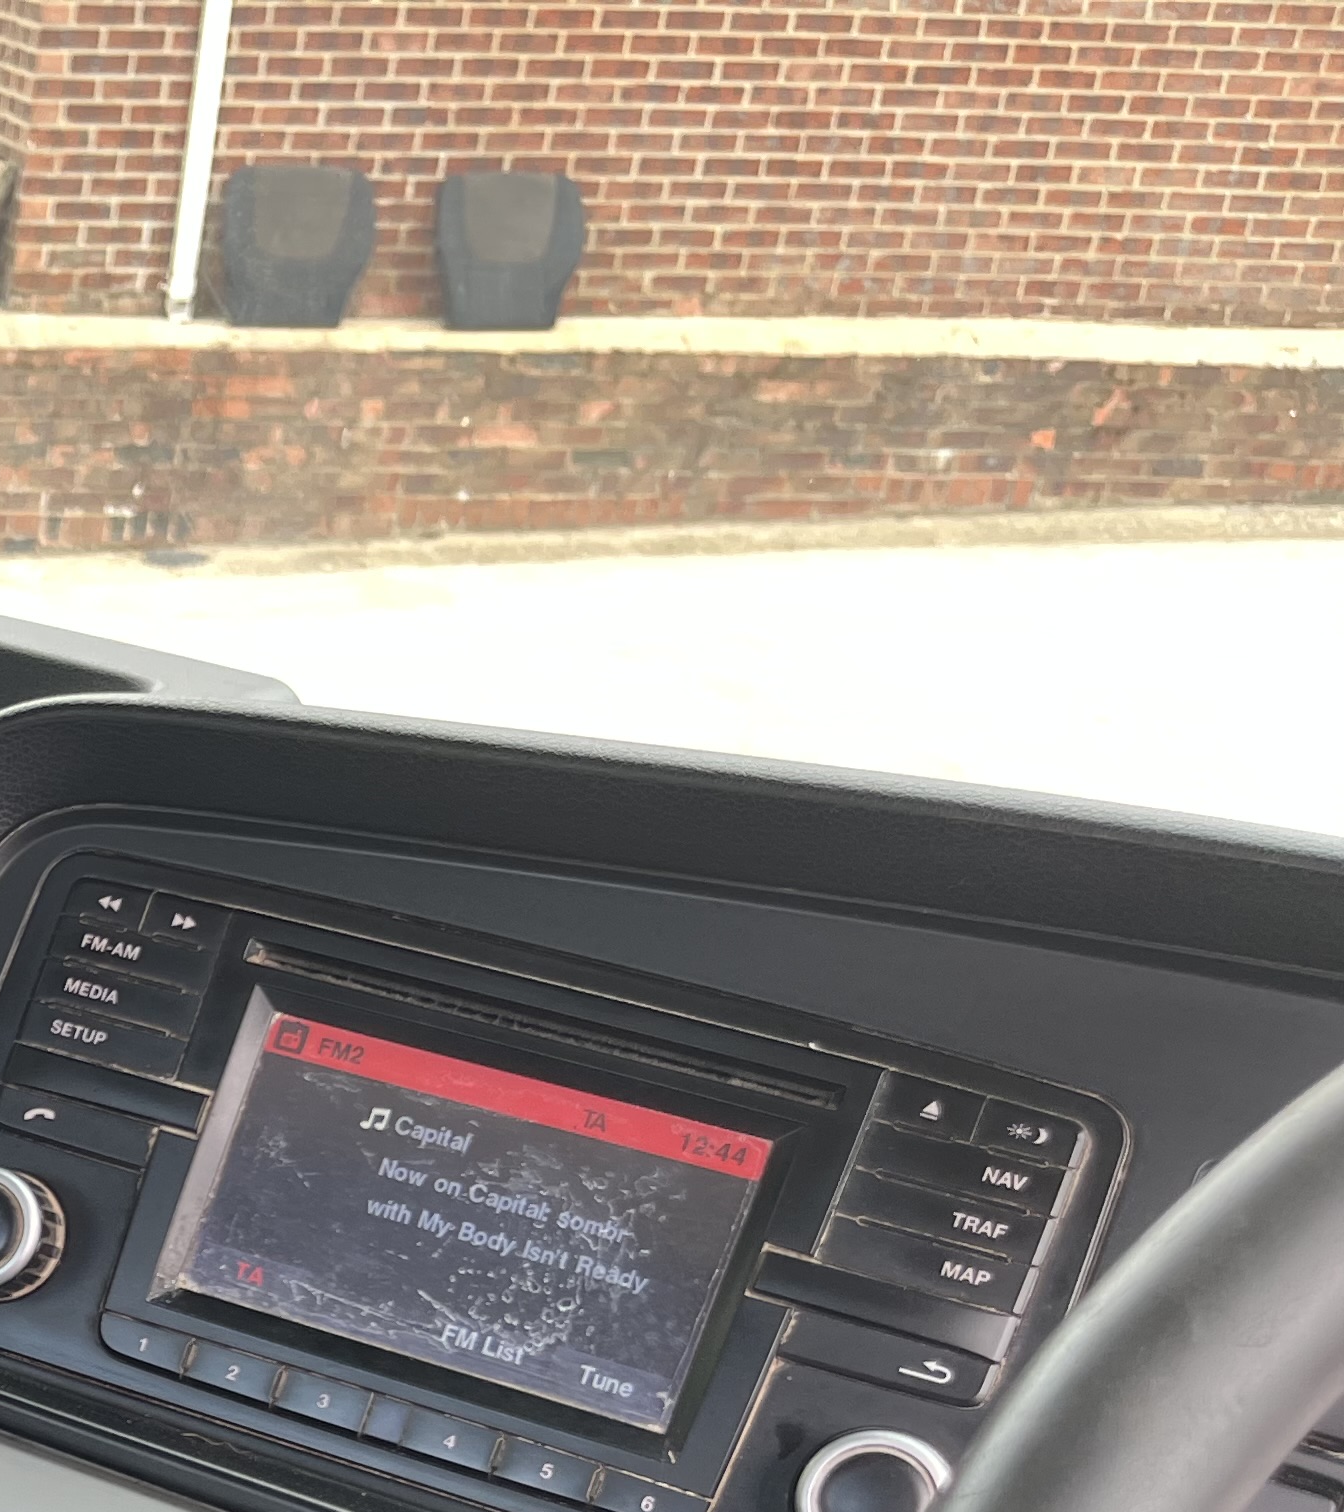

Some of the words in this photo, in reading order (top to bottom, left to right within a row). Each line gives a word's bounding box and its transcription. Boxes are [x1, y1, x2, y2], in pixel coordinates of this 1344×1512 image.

[81, 933, 141, 961] FM-AM
[63, 975, 119, 1005] MEDIA
[50, 1018, 108, 1046] SETUP
[317, 1037, 365, 1065] FM2
[583, 1107, 607, 1133] TA
[394, 1115, 473, 1154] Capital
[678, 1131, 747, 1167] 12:44
[377, 1157, 428, 1187] Now
[433, 1178, 463, 1199] on
[981, 1166, 1028, 1191] NAV
[952, 1211, 1008, 1239] TRAF
[367, 1200, 413, 1226] with
[417, 1209, 452, 1239] My
[458, 1221, 518, 1257] Body
[522, 1242, 569, 1271] Isn't
[574, 1254, 650, 1296] Ready
[237, 1261, 264, 1286] TA
[940, 1261, 991, 1286] MAP
[138, 1336, 148, 1353] 1
[441, 1324, 479, 1351] FM
[481, 1335, 525, 1366] List
[225, 1364, 240, 1382] 2
[580, 1364, 634, 1398] Tune
[316, 1393, 330, 1410] 3
[442, 1434, 456, 1451] 4
[539, 1462, 553, 1480] 5
[640, 1495, 655, 1512] 6
